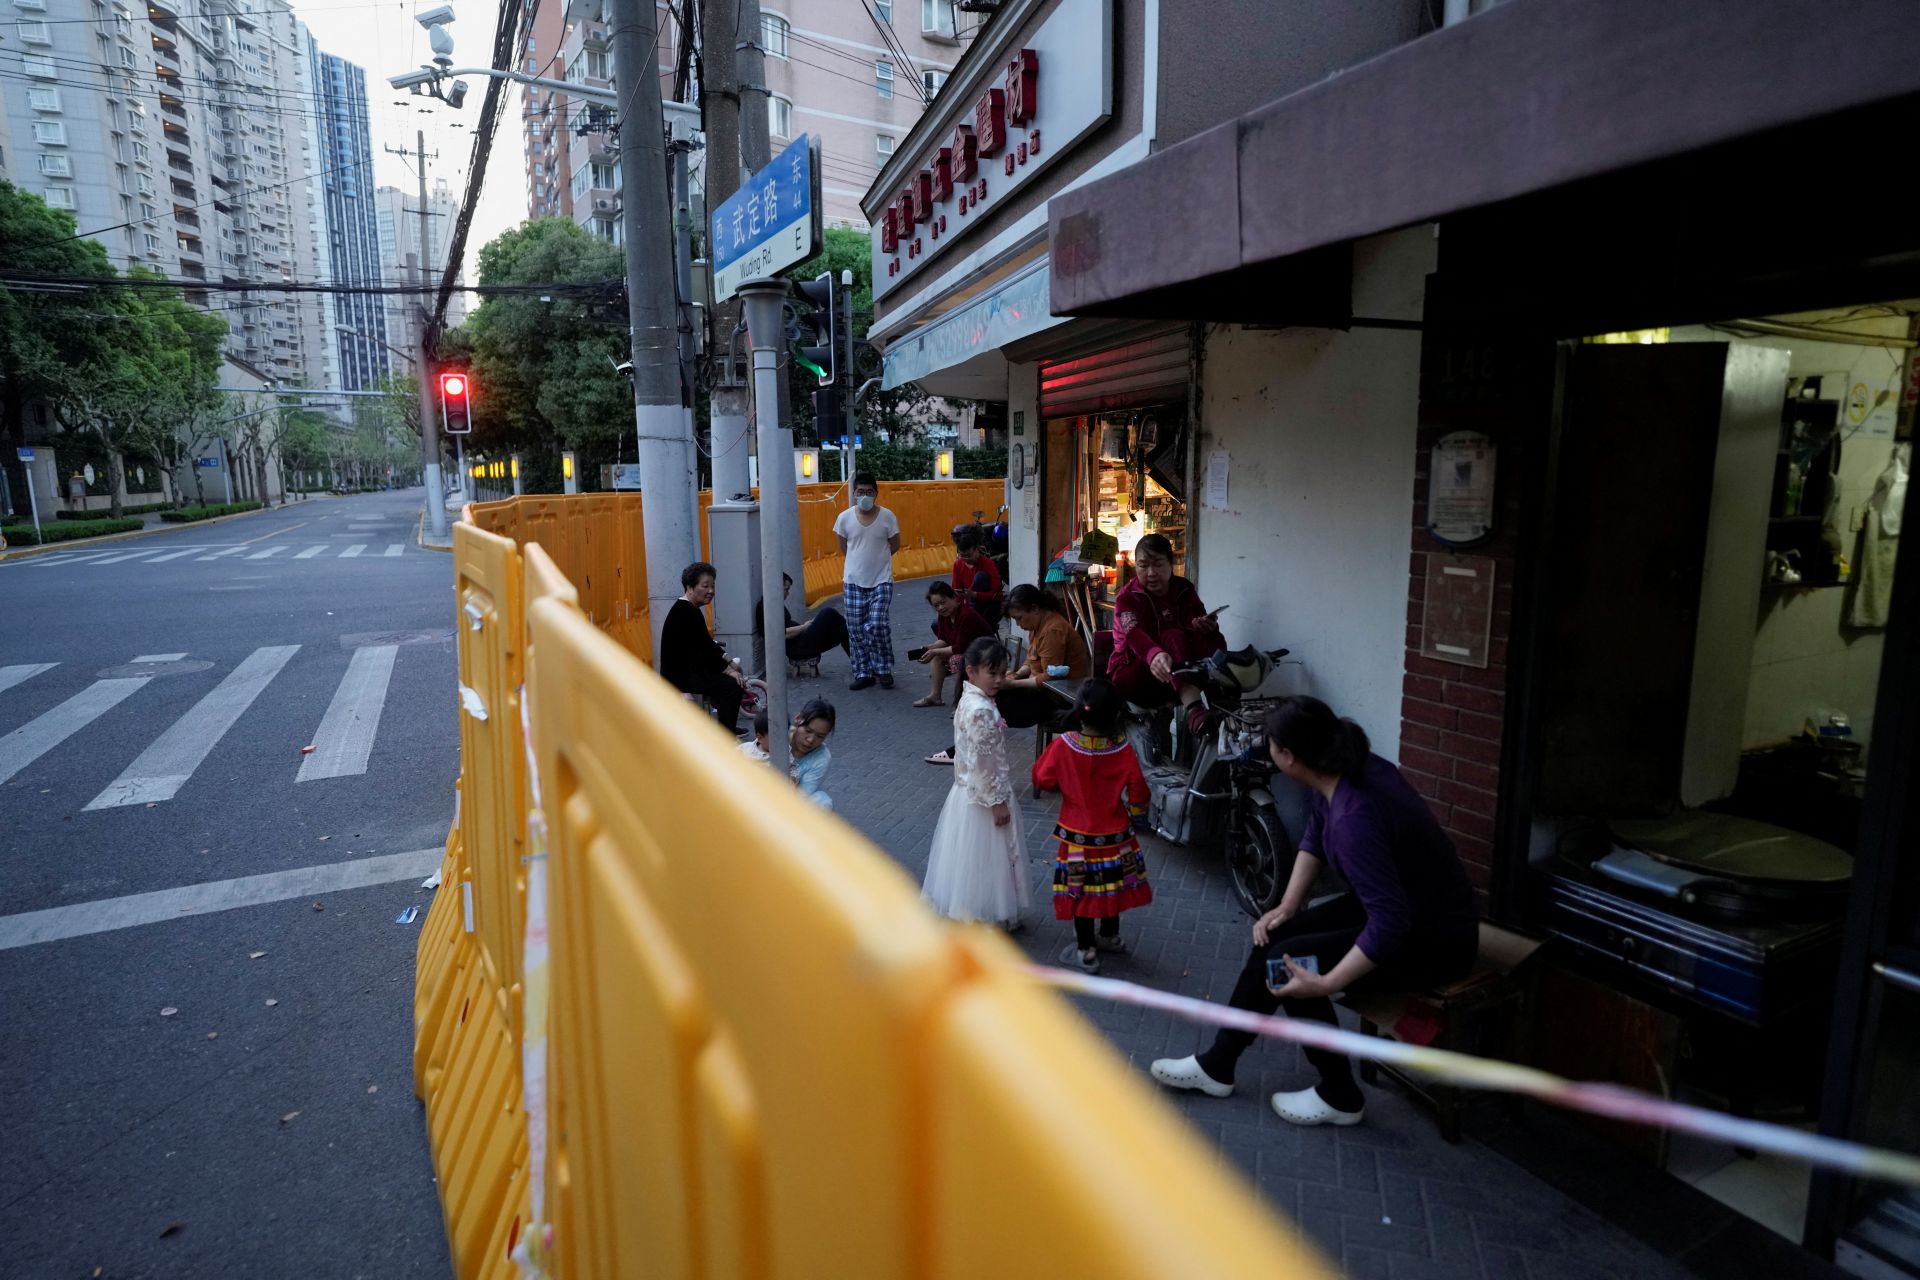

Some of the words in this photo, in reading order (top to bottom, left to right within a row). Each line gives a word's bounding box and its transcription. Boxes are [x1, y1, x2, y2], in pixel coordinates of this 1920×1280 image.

[792, 155, 802, 185] 东
[732, 178, 778, 249] 武定路
[716, 217, 723, 241] 西
[795, 227, 802, 251] E
[739, 256, 761, 279] Wuding
[718, 275, 725, 295] W
